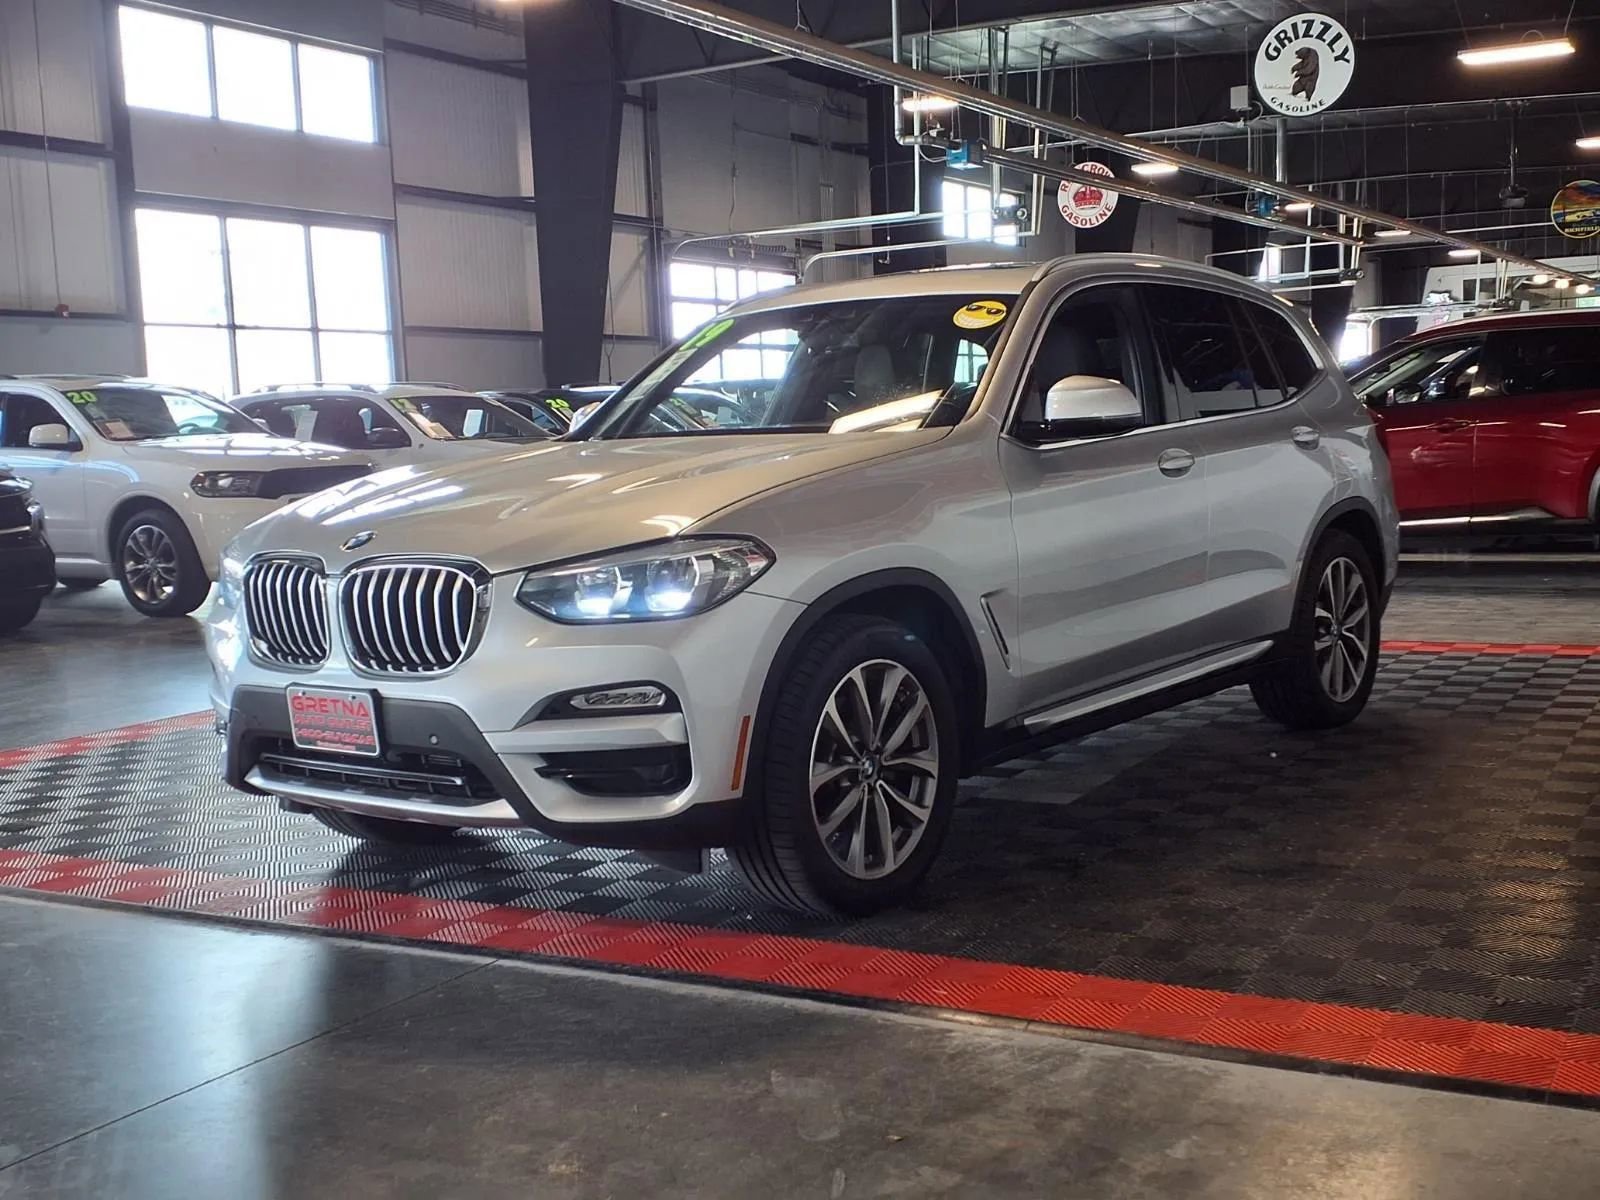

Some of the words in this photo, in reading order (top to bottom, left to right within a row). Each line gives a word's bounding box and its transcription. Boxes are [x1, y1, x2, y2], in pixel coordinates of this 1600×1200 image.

[1264, 18, 1351, 64] GRIZZLY
[1270, 96, 1327, 113] GASOLINE
[1061, 202, 1114, 227] GASOLINE
[66, 391, 98, 404] 20
[545, 398, 570, 409] 20
[292, 695, 370, 718] GRETNA
